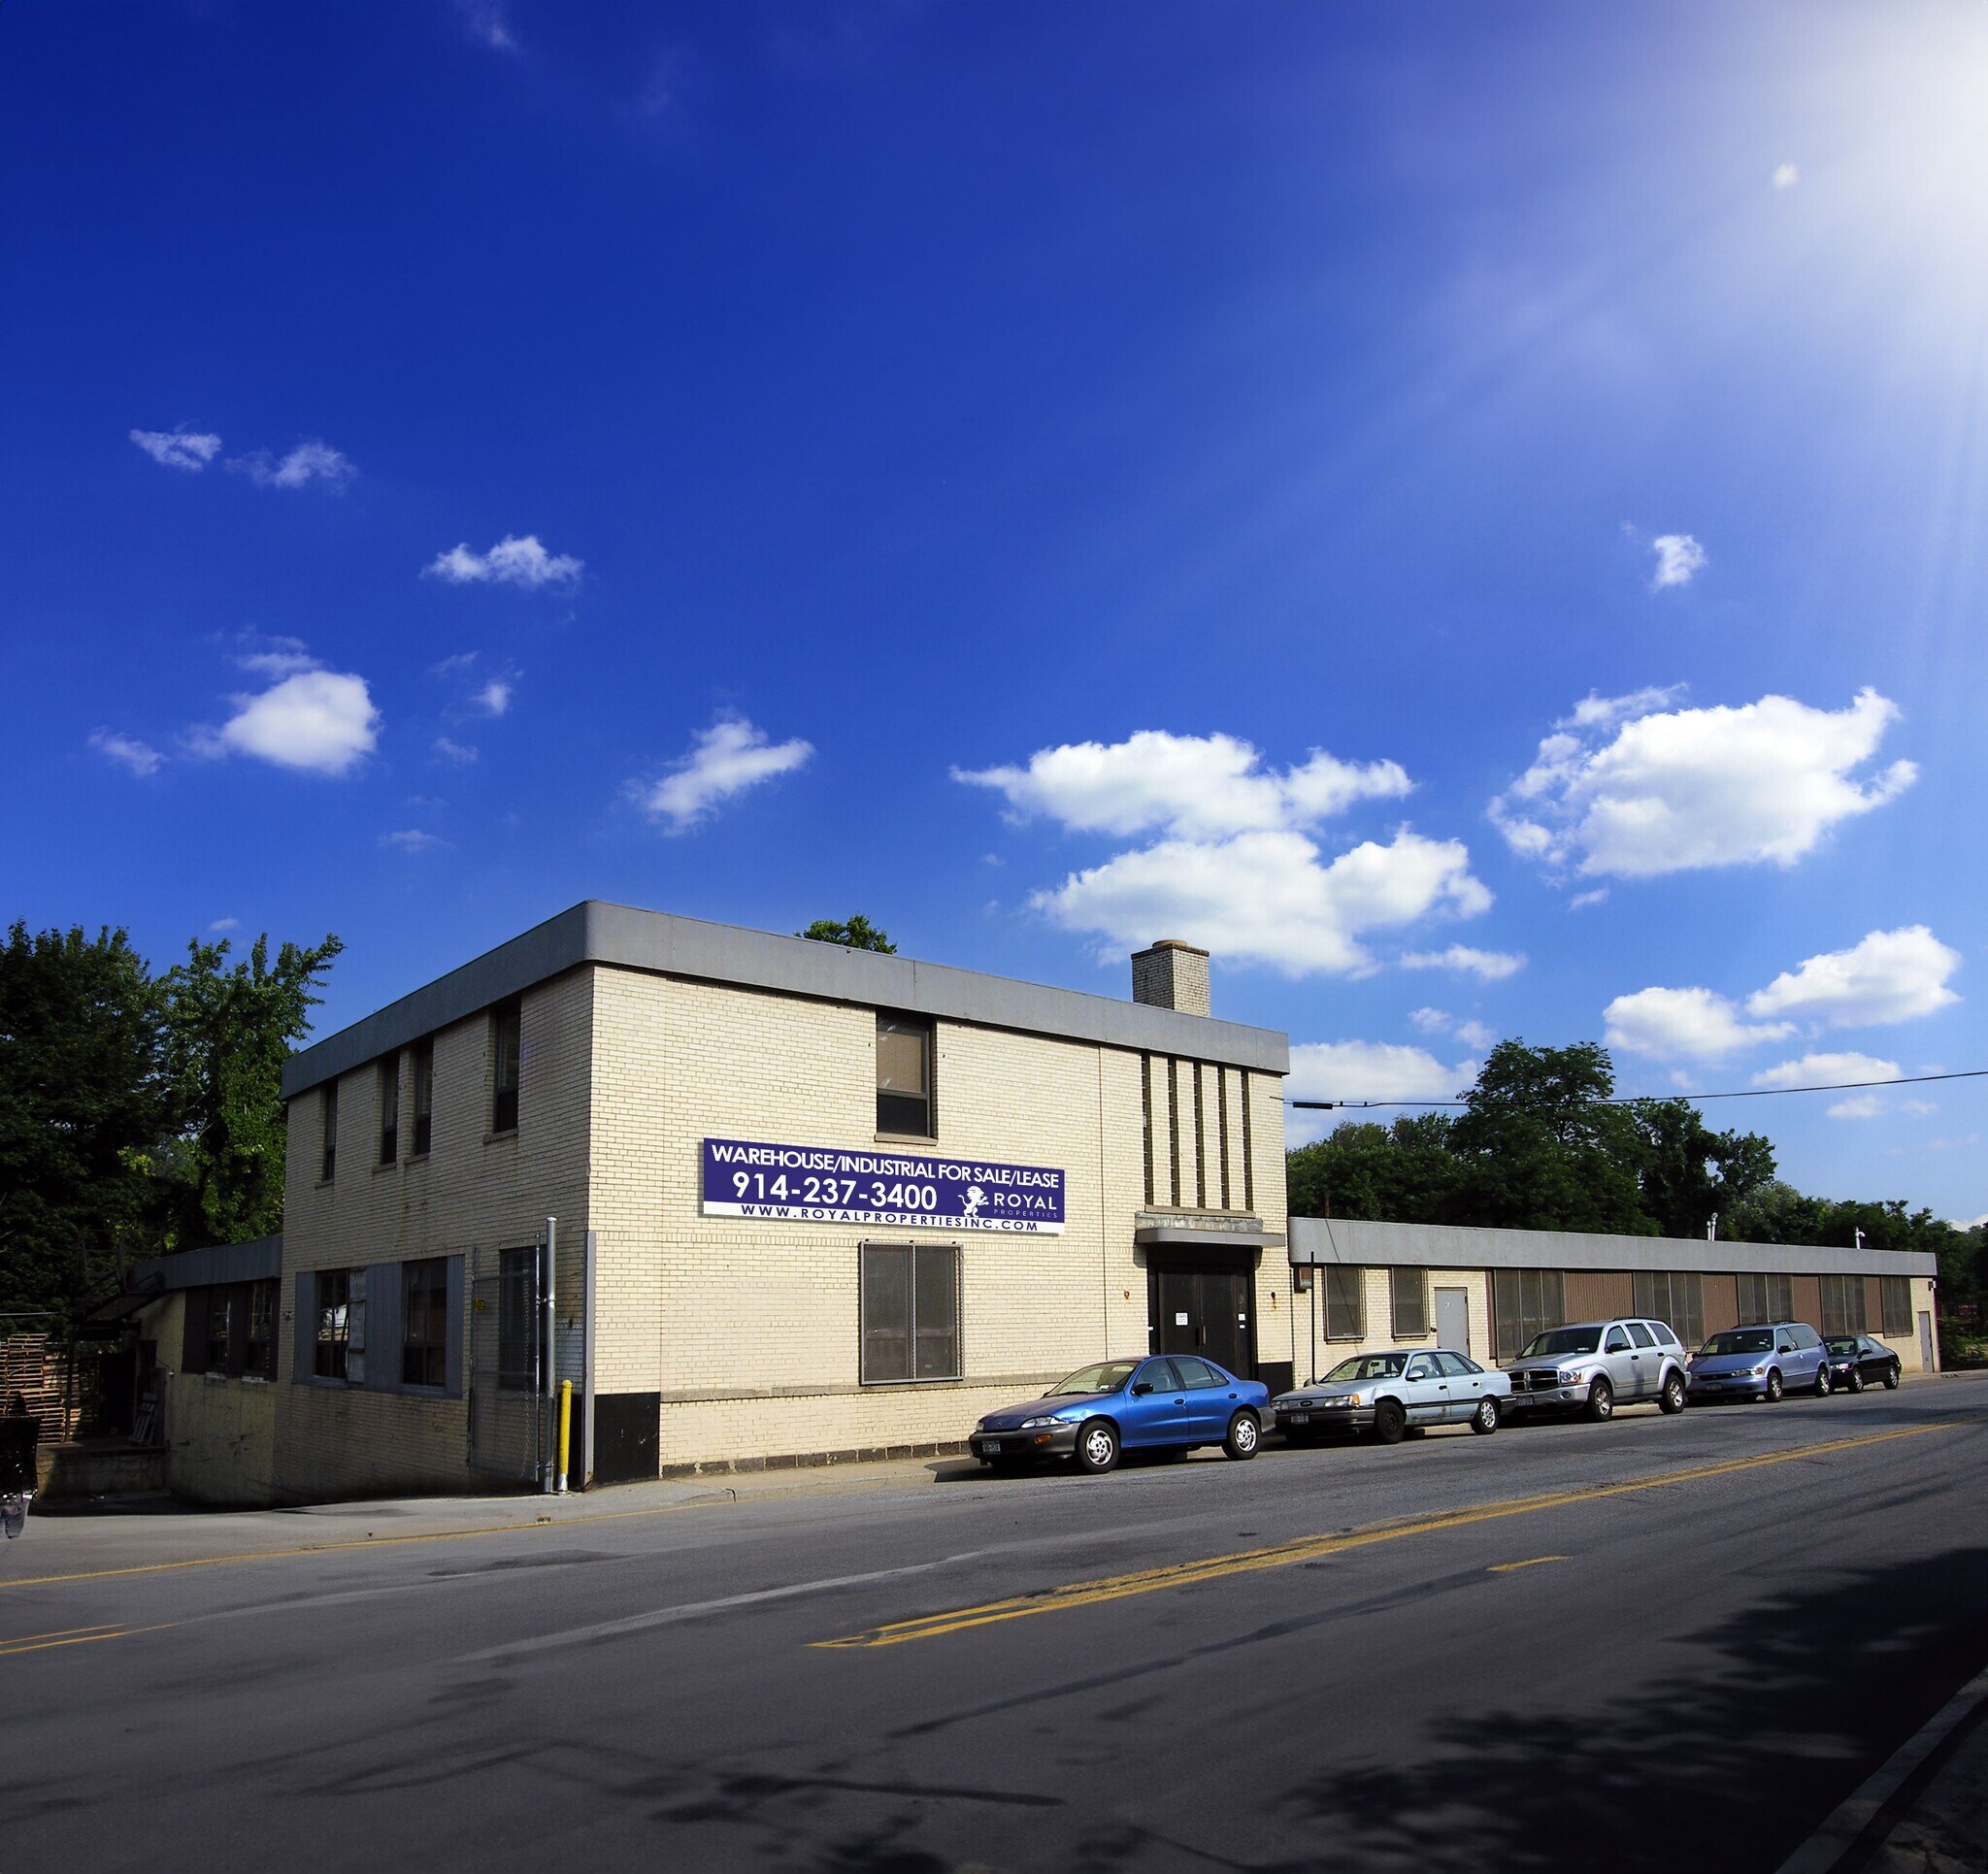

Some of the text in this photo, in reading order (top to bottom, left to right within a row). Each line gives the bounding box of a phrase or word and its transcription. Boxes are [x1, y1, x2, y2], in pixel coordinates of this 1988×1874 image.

[712, 1144, 1059, 1189] WAREHOUSE/INDUSTRIAL FOR SALE/LEASE
[732, 1171, 938, 1210] 914-237-3400
[994, 1192, 1057, 1210] ROYAL
[742, 1204, 1038, 1232] WWW.ROYALPROPERTIESINC.COM
[993, 1208, 1058, 1219] PROPERTIES
